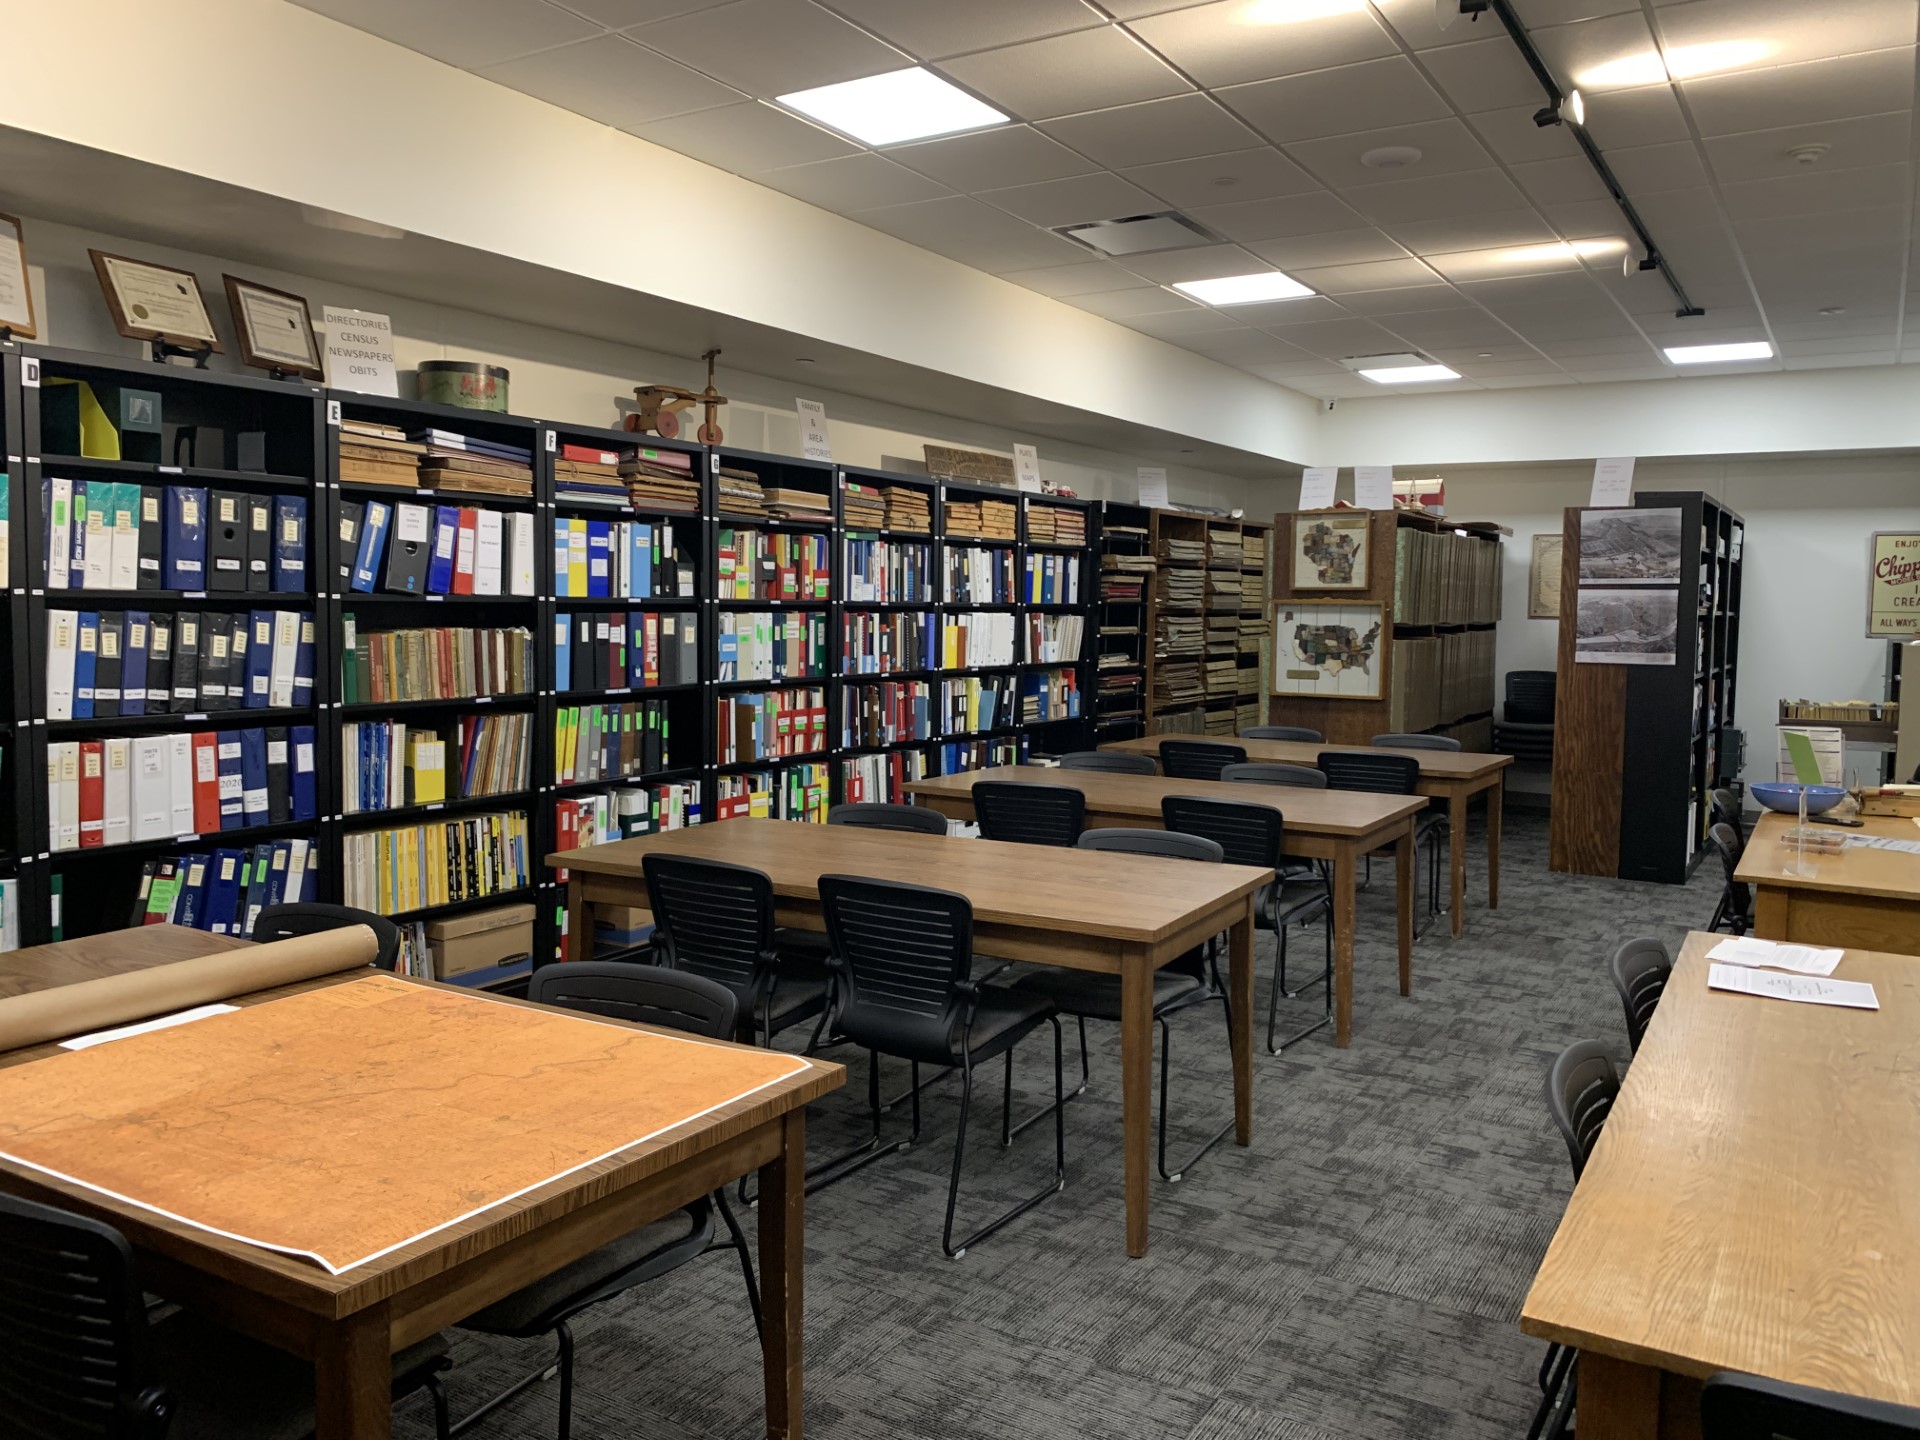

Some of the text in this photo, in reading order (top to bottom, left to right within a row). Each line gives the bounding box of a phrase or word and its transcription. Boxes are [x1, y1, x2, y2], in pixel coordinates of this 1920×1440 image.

[326, 314, 389, 331] DIRECTORIES
[340, 332, 379, 345] CENSUS
[328, 346, 394, 363] NEWSPAPERS
[27, 363, 39, 381] D
[349, 365, 378, 377] OBITS
[331, 405, 339, 420] E
[801, 401, 821, 412] FAMILY
[549, 435, 554, 447] F
[809, 433, 823, 443] AREA
[804, 447, 832, 459] HISTORIES
[713, 458, 719, 470] G
